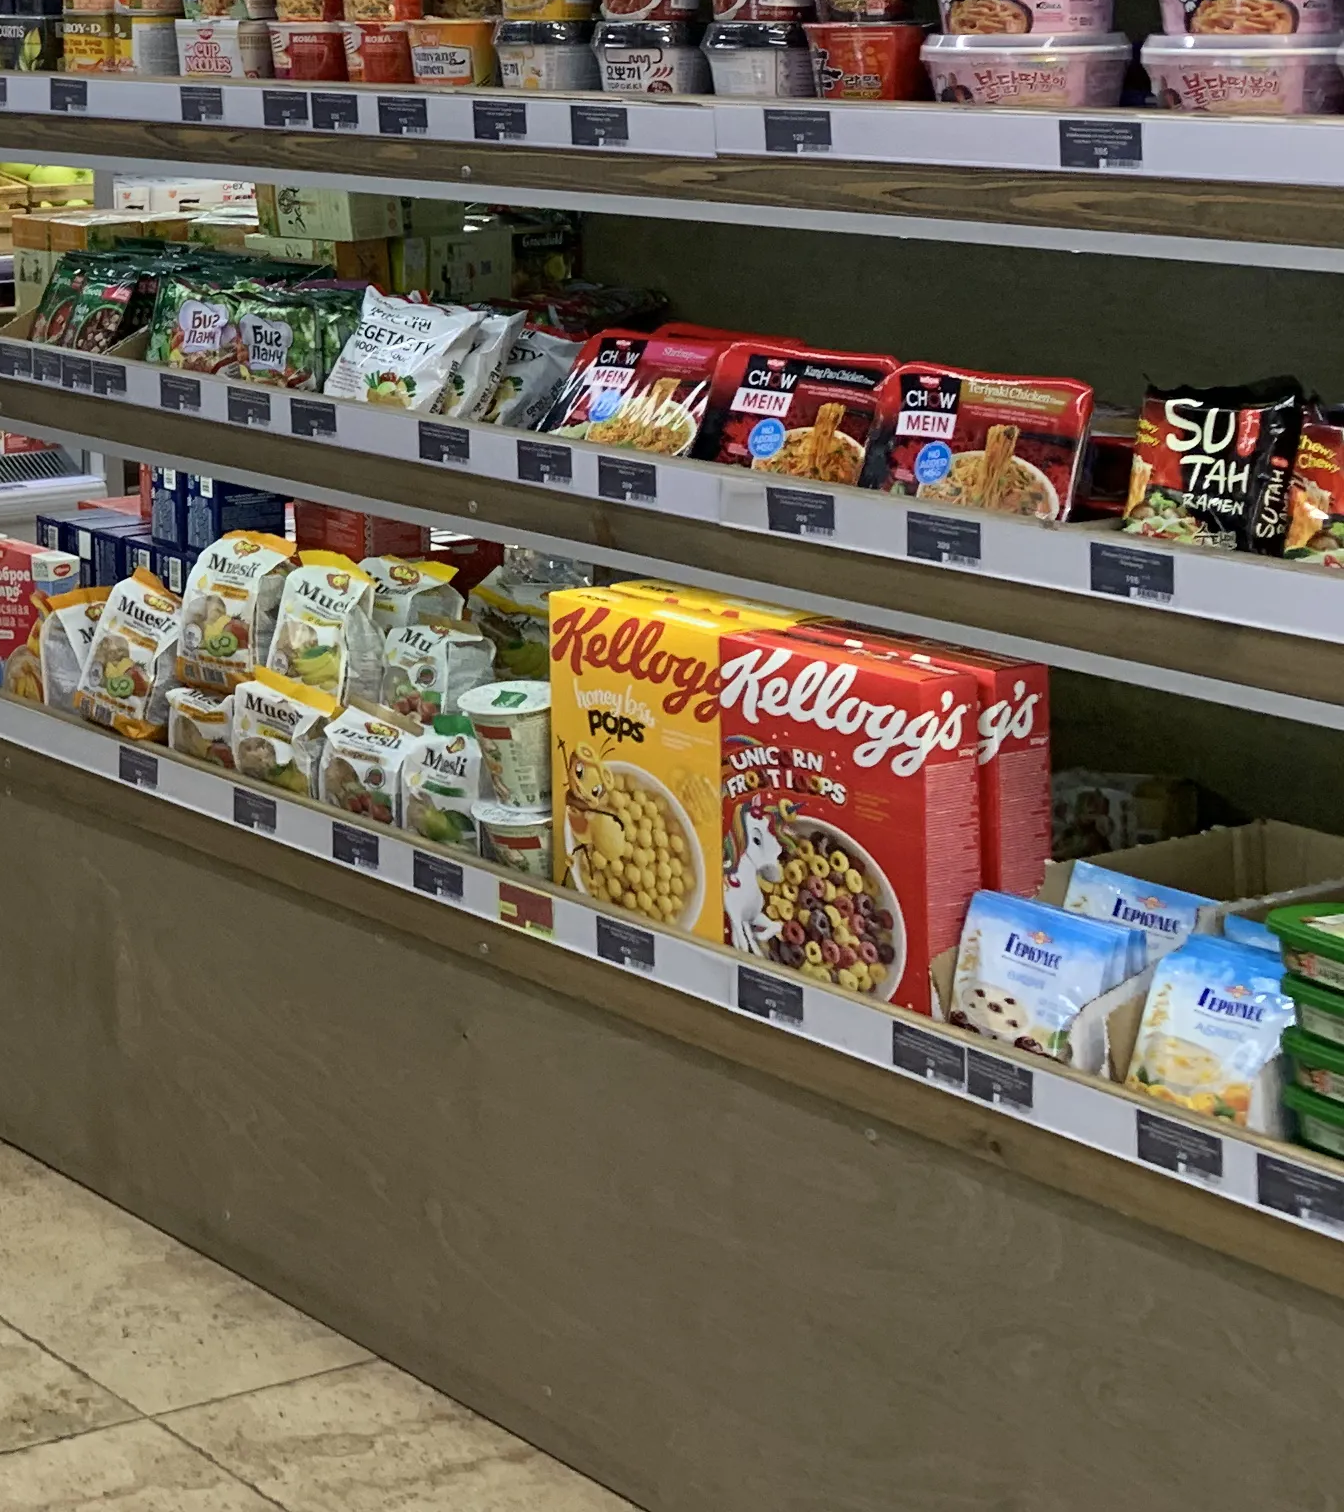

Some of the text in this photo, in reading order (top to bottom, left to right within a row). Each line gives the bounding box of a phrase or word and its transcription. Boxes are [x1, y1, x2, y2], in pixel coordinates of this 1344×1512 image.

[194, 43, 220, 57] CUP
[185, 56, 232, 73] NOODLES
[607, 65, 641, 80] 요뽀끼
[191, 311, 220, 330] Биг
[185, 328, 217, 347] Ланч
[253, 326, 282, 349] Биг
[251, 344, 284, 368] Ланч
[600, 350, 640, 366] CHOW
[592, 369, 627, 384] MEIN
[748, 369, 798, 389] CHOW
[742, 393, 786, 411] MEIN
[906, 388, 957, 411] CHOW
[968, 382, 1050, 404] Teriyaki Chicken
[905, 415, 950, 435] MEIN
[1164, 398, 1235, 453] SU
[1180, 455, 1251, 493] TAH
[1182, 493, 1244, 516] RAMEN
[207, 554, 260, 579] Muesli
[117, 597, 176, 634] Muesli
[720, 649, 967, 776] Kellogg's
[588, 709, 646, 744] pops
[422, 750, 467, 778] Muesli
